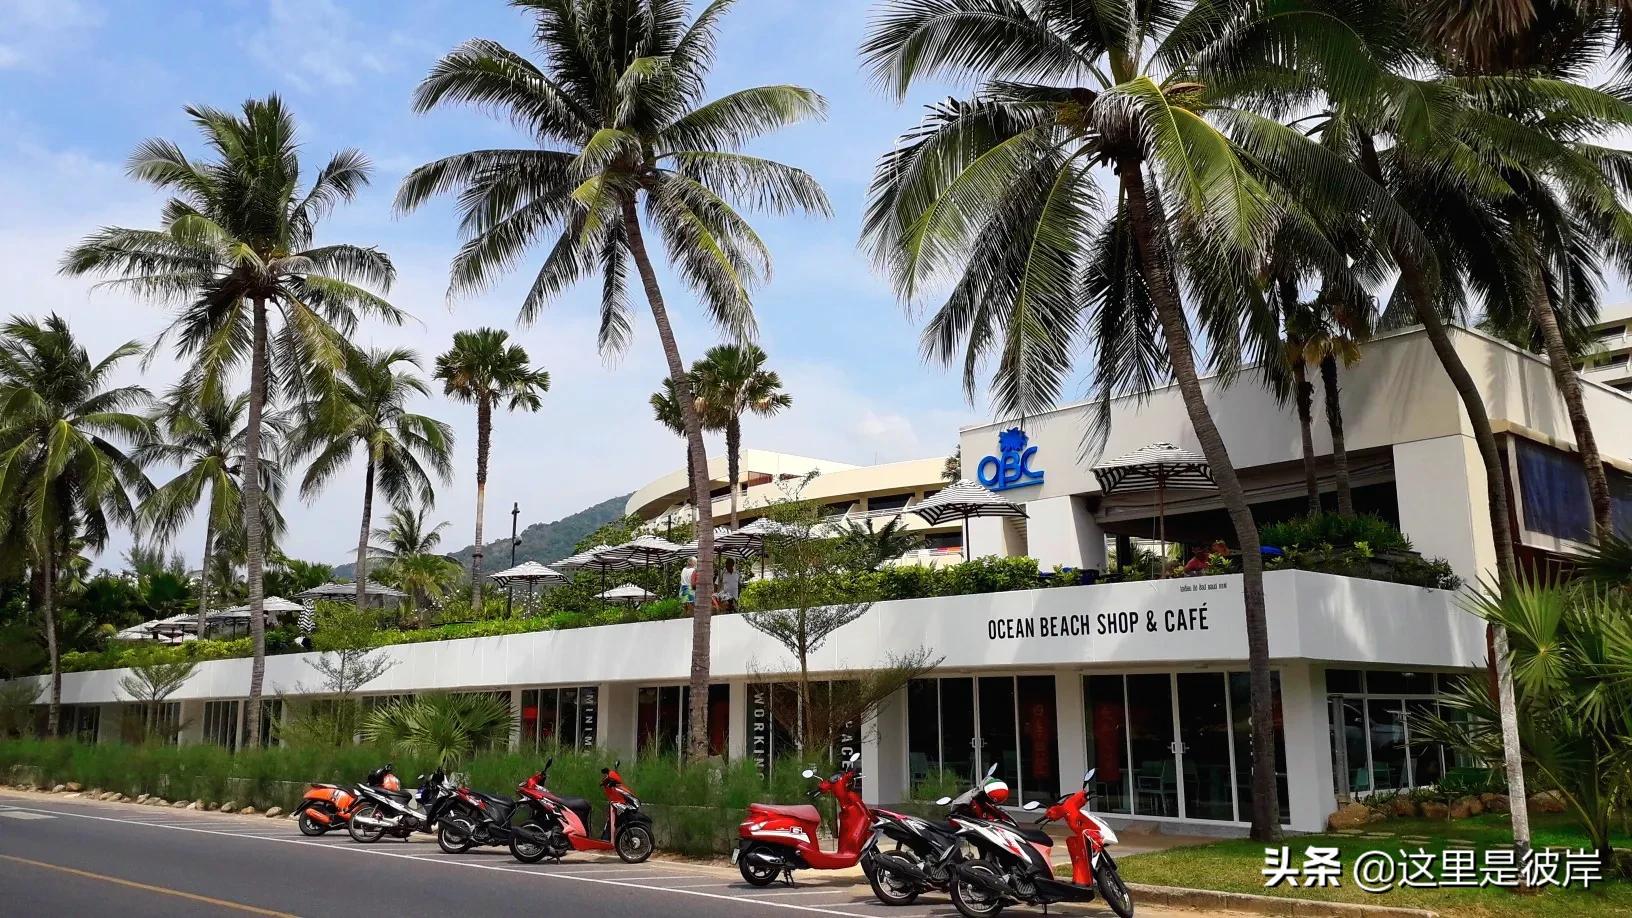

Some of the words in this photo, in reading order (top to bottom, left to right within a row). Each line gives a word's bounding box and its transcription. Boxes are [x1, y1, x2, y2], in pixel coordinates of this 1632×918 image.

[977, 446, 1044, 489] OBC
[988, 617, 1035, 640] OCEAN
[1040, 614, 1090, 638] BEACH
[1097, 611, 1139, 635] SHOP
[1146, 609, 1158, 633] &
[1164, 602, 1209, 633] CAFÉ
